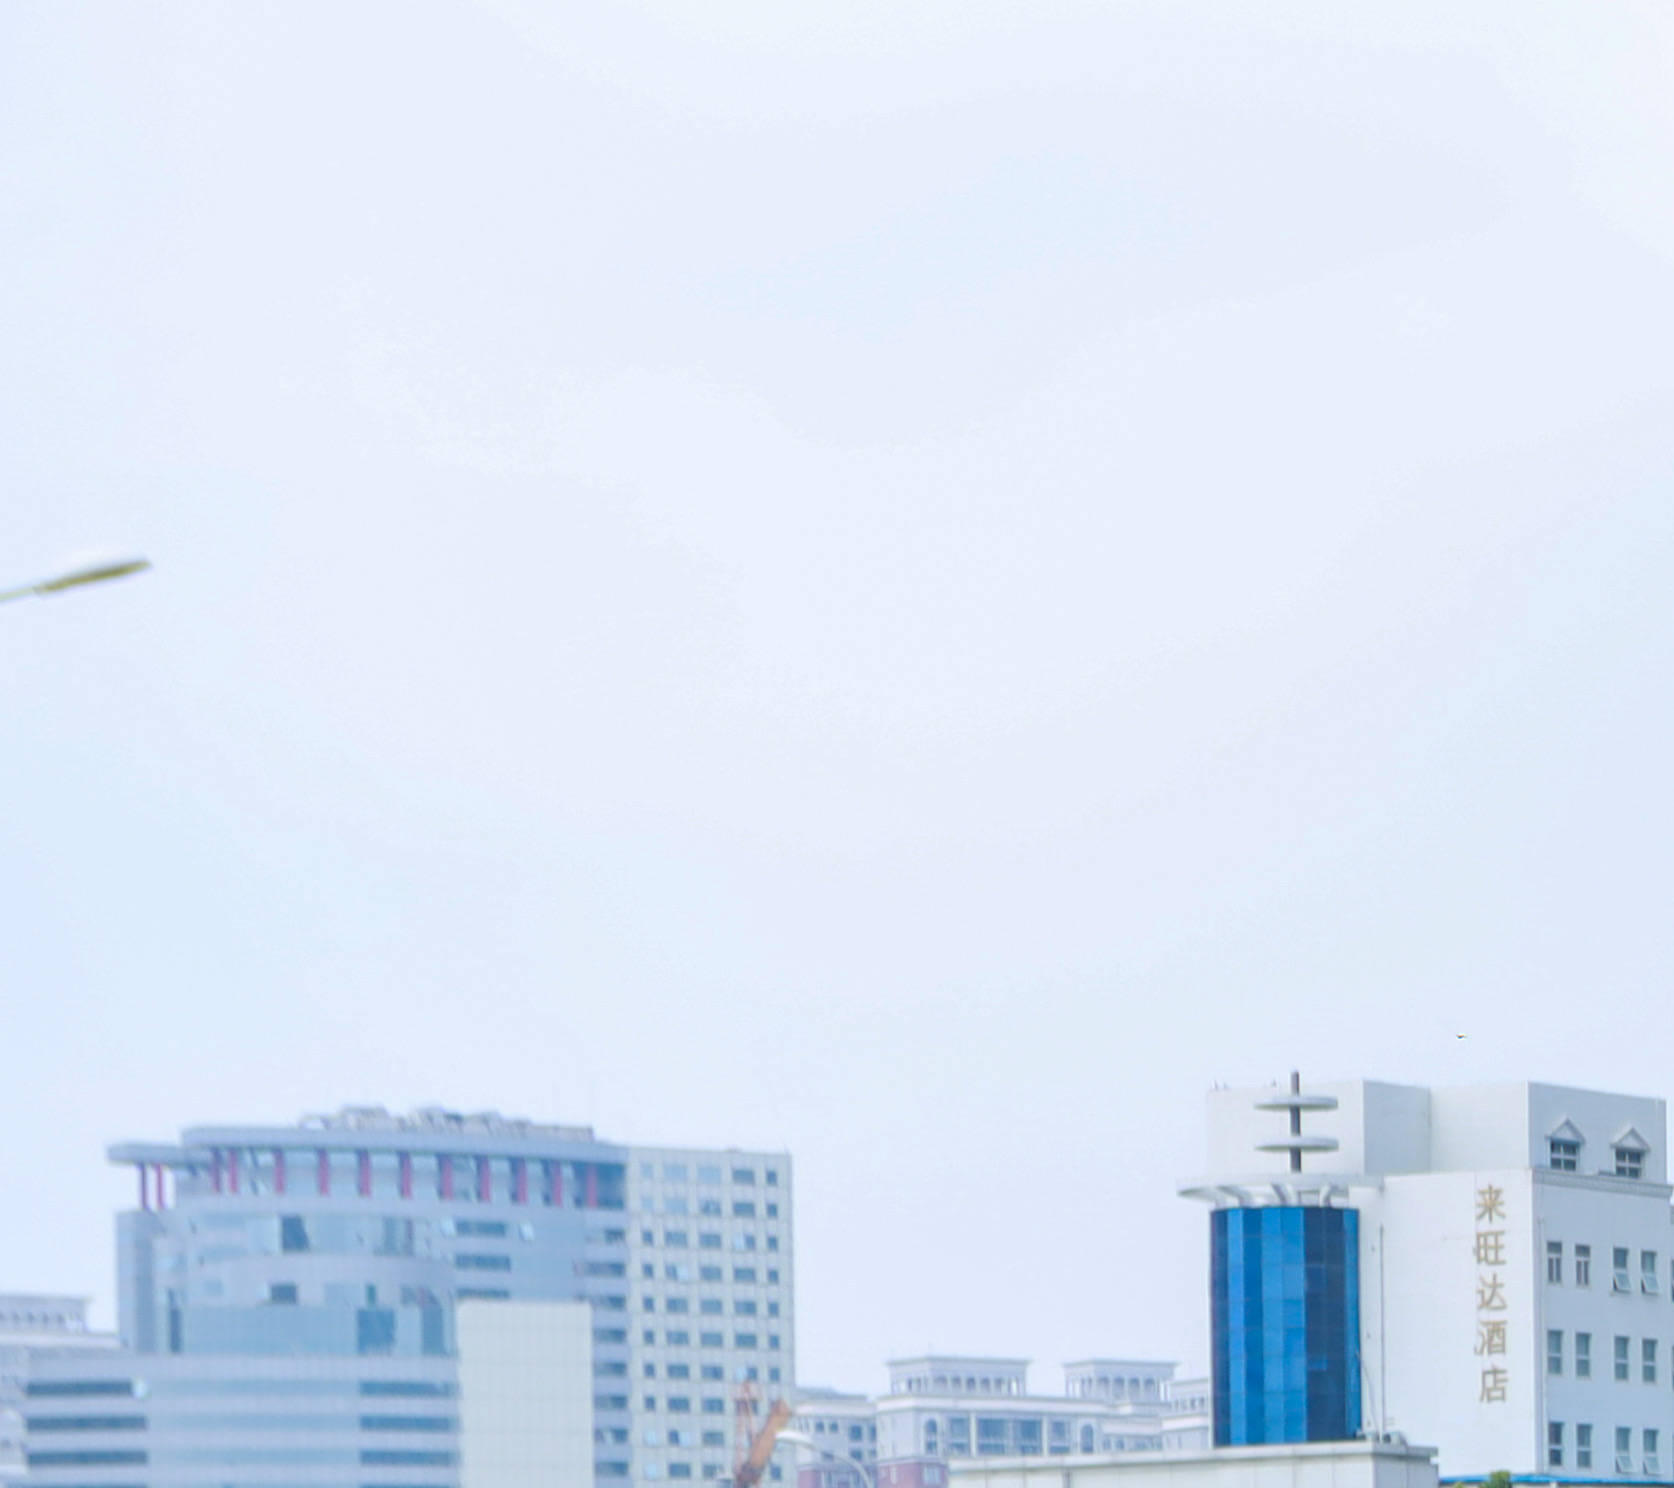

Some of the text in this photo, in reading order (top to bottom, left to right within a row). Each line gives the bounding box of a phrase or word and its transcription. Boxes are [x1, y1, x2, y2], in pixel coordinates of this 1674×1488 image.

[1474, 1184, 1508, 1403] 来旺达酒店
